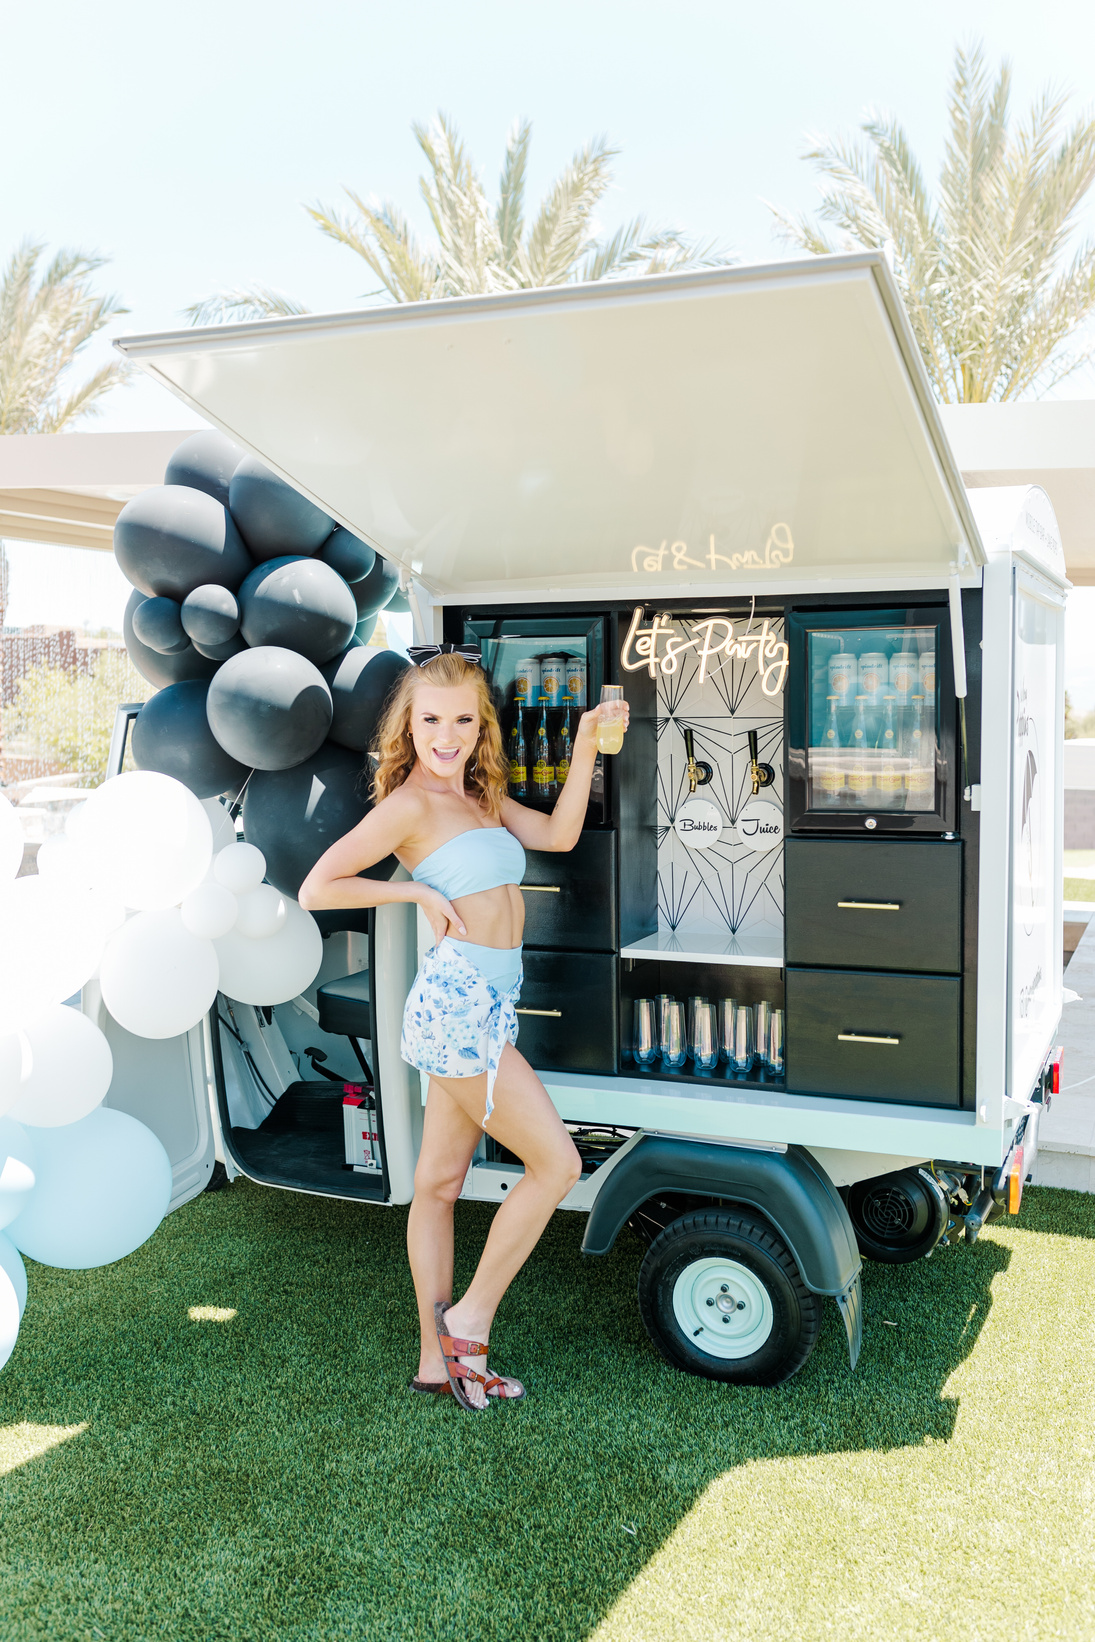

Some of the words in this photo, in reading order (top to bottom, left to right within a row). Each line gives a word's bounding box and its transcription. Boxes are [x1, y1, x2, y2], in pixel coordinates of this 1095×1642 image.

[622, 607, 700, 678] Let's
[691, 618, 789, 696] Party
[679, 818, 718, 832] Bubbles
[741, 818, 781, 836] Juice
